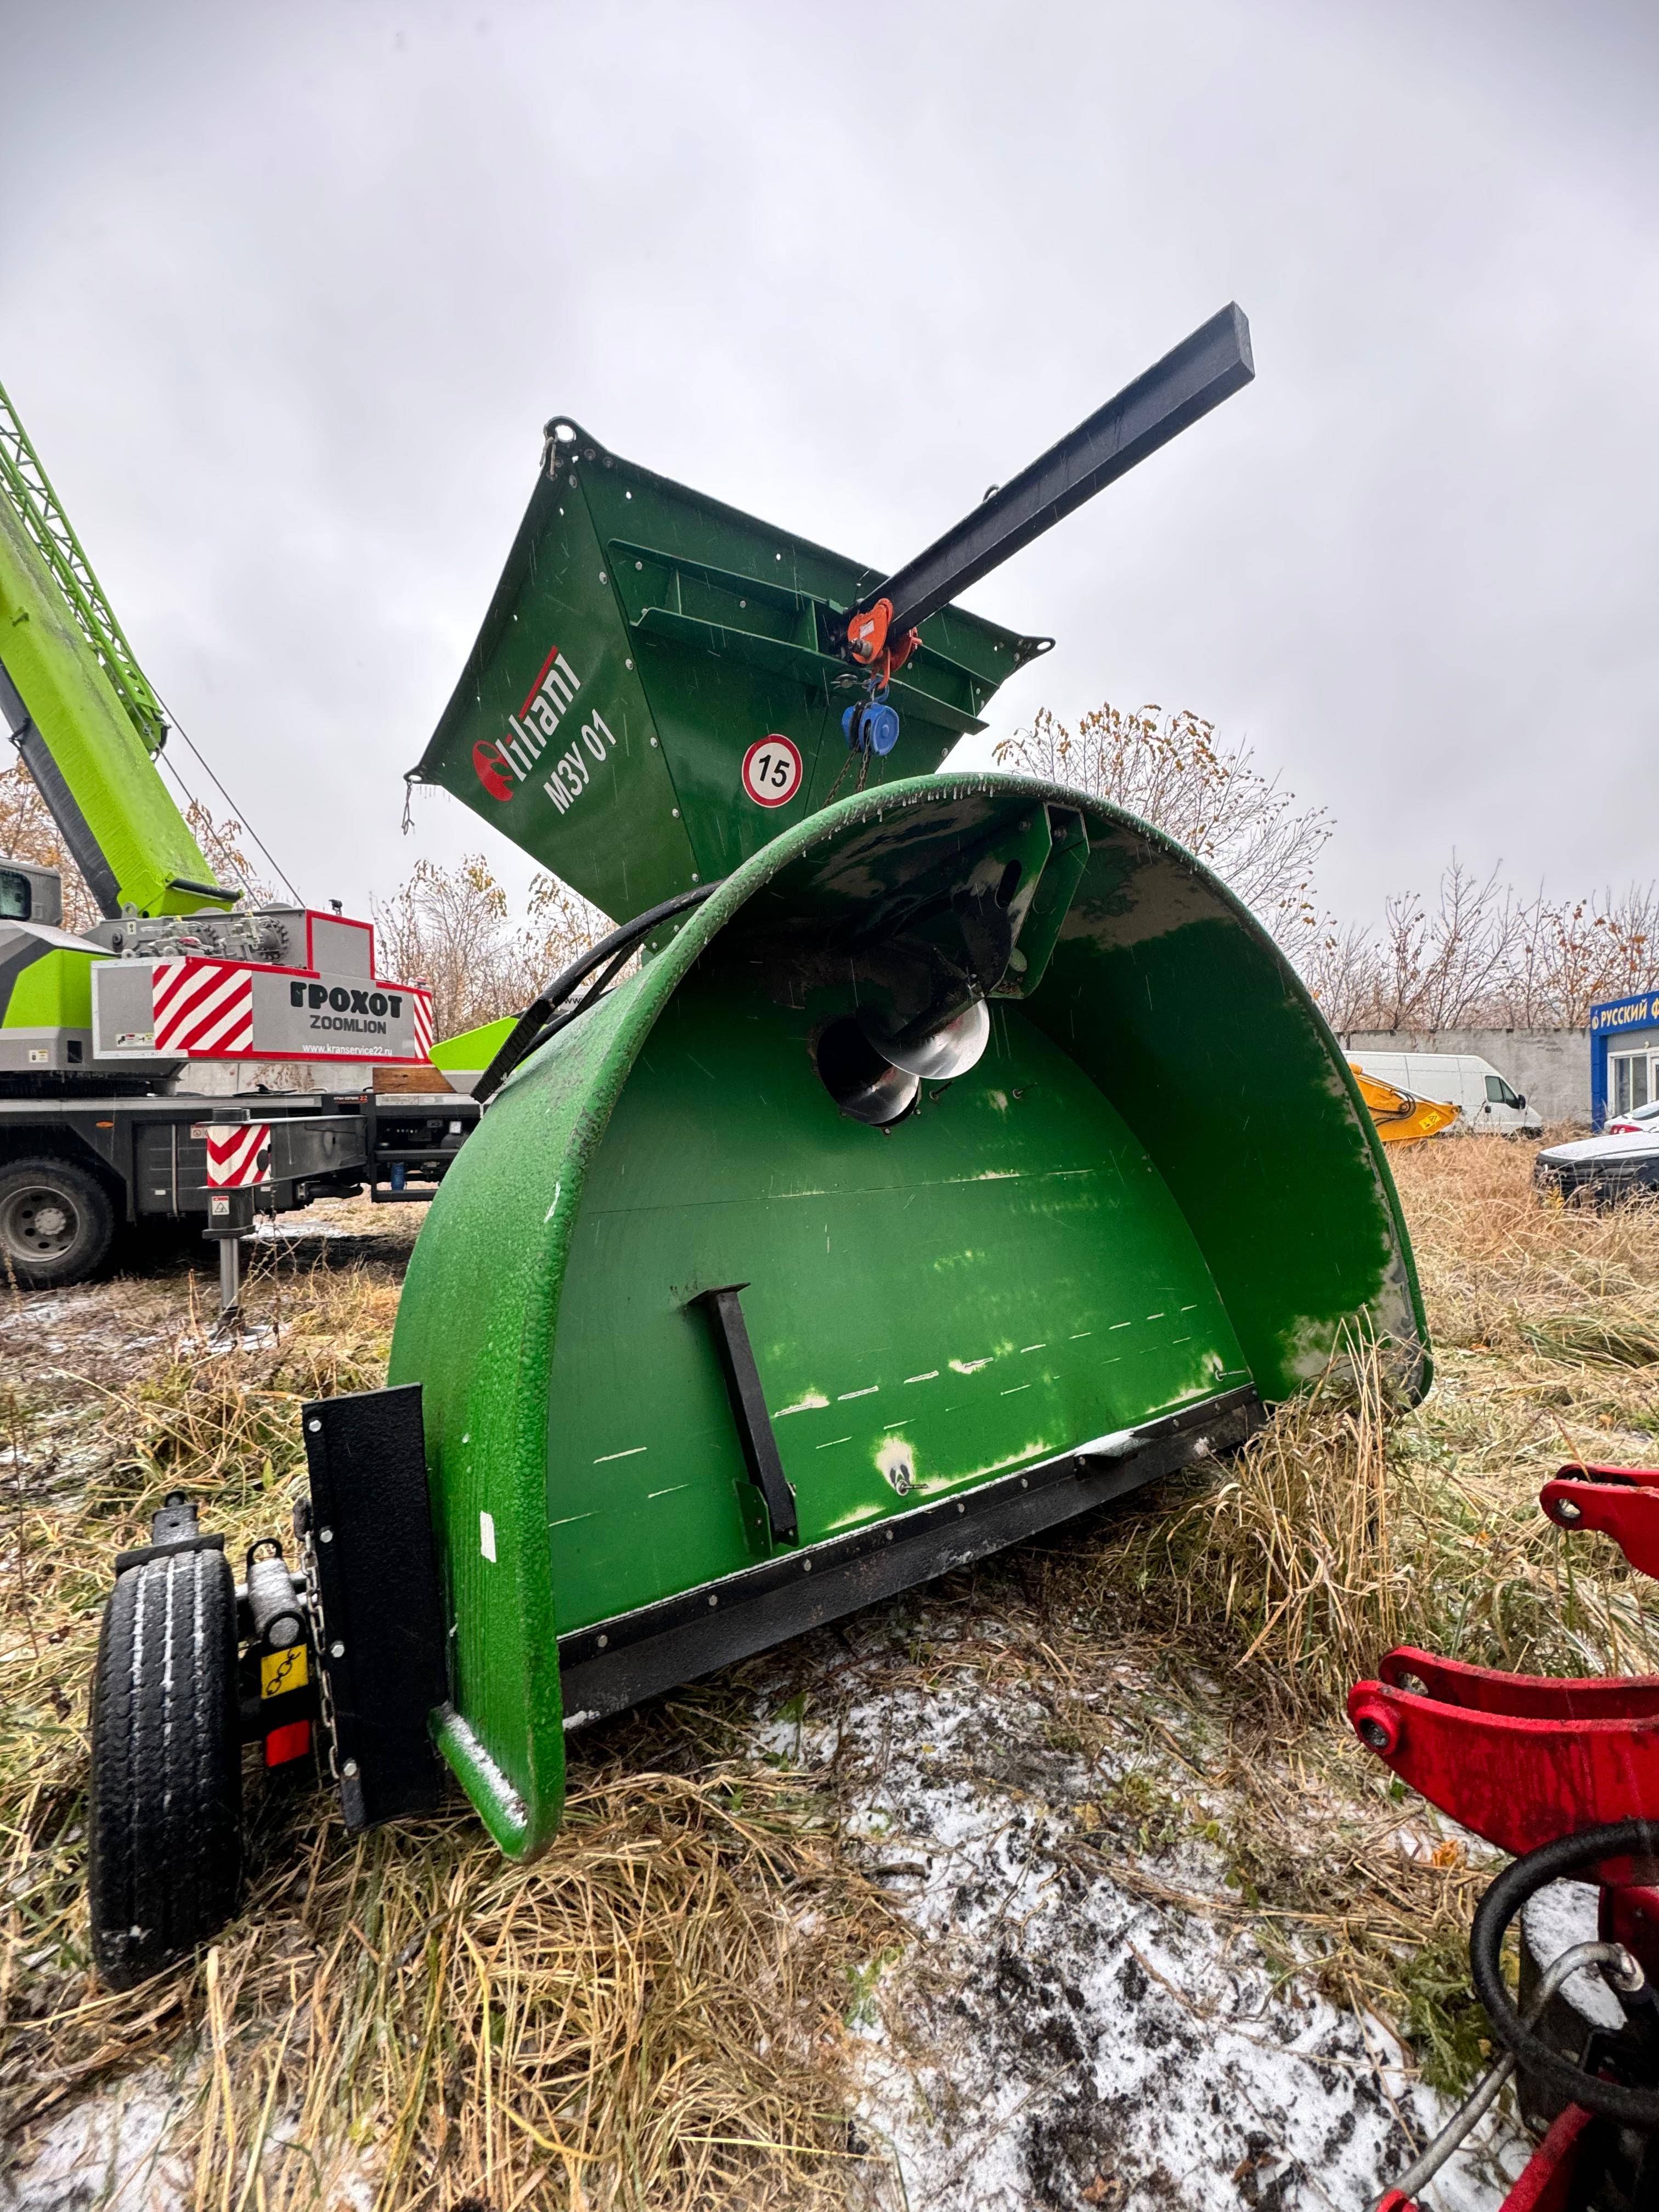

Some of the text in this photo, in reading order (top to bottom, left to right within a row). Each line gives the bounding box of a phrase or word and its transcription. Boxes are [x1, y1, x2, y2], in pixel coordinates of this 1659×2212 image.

[582, 708, 617, 761] 01
[759, 754, 790, 787] 15
[290, 981, 402, 1018] ГРОХОТ
[1600, 998, 1647, 1028] РУССКИЙ
[309, 1014, 386, 1034] ZOOMLION
[302, 1043, 393, 1056] www.kranservice22.ru
